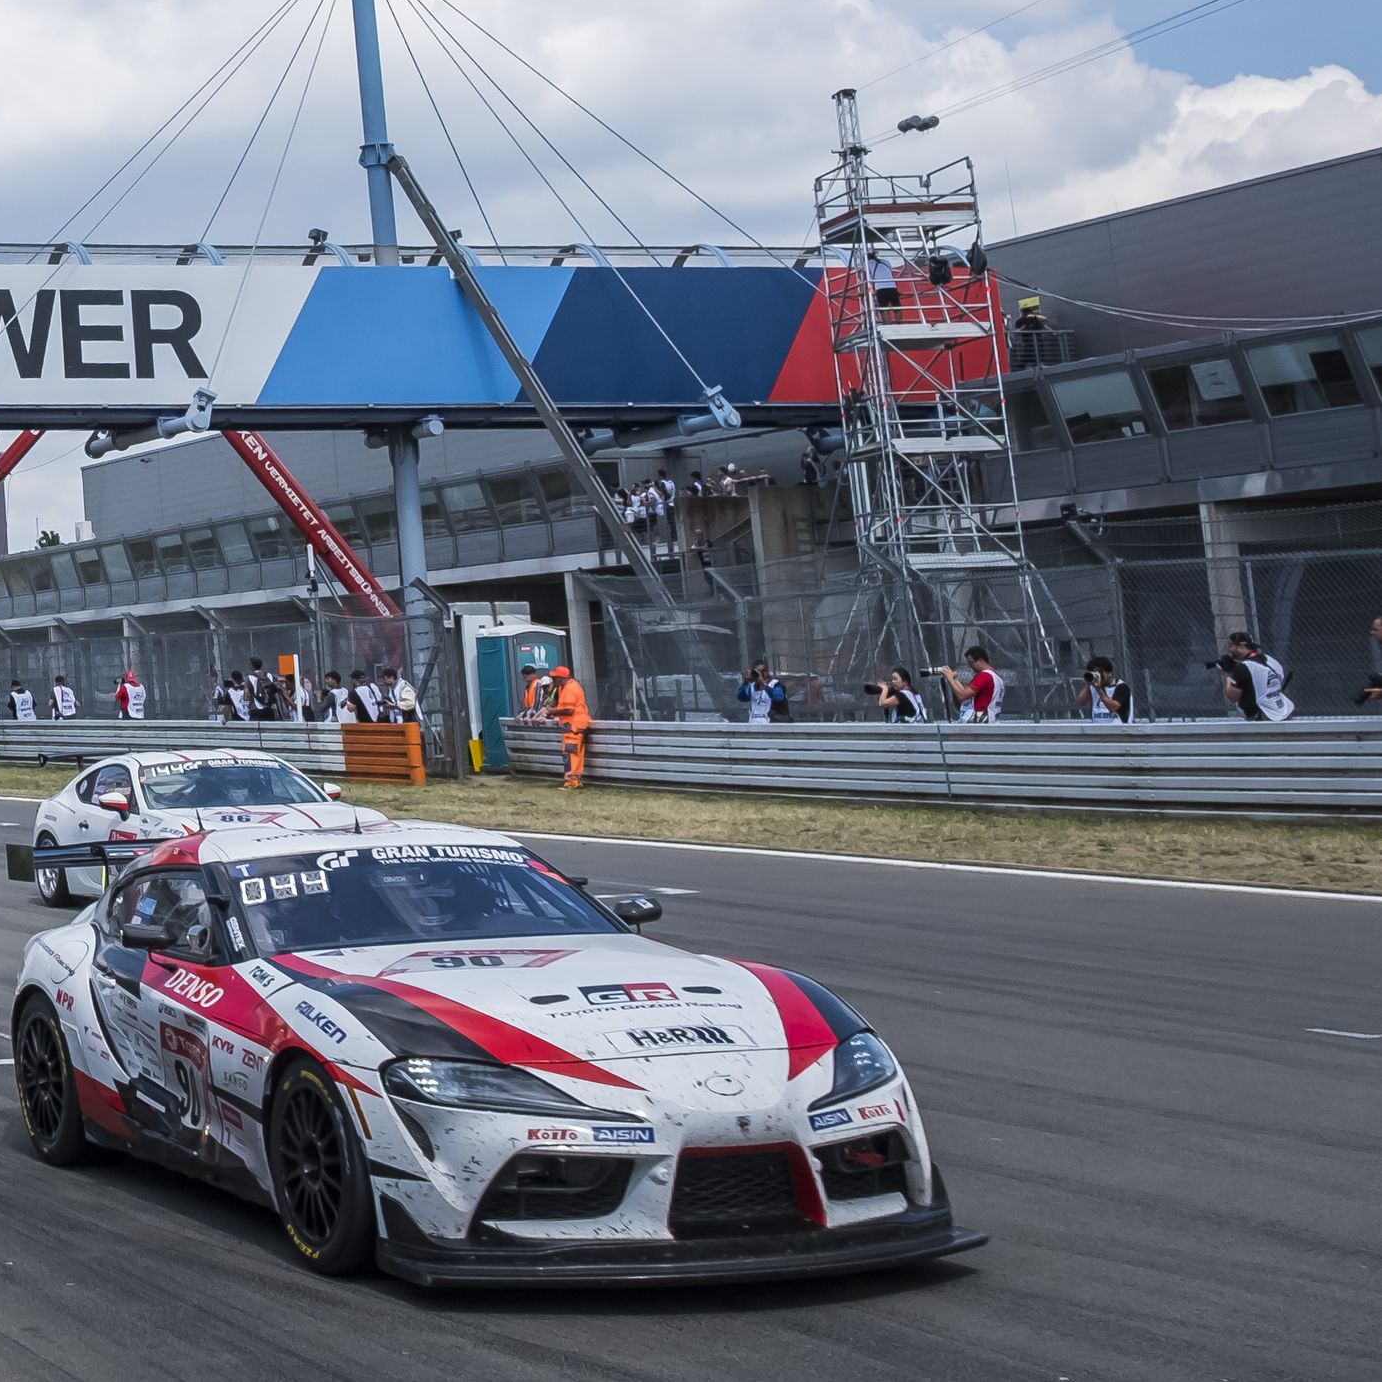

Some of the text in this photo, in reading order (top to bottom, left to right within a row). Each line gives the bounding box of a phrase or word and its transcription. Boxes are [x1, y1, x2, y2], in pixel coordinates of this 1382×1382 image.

[265, 461, 319, 526] VERMIETET
[207, 759, 279, 769] GRAN TURISMO
[220, 814, 252, 824] 86
[372, 846, 525, 864] GRAN TURISMO
[240, 871, 330, 905] 044
[431, 955, 505, 969] 90
[164, 968, 225, 1008] DENSO
[55, 989, 75, 1012] NPR
[545, 1001, 743, 1019] TOYOTA GAZOO Racing
[294, 1000, 347, 1044] FALKEN
[813, 1110, 849, 1128] AISIN
[597, 1129, 651, 1141] AISIN
